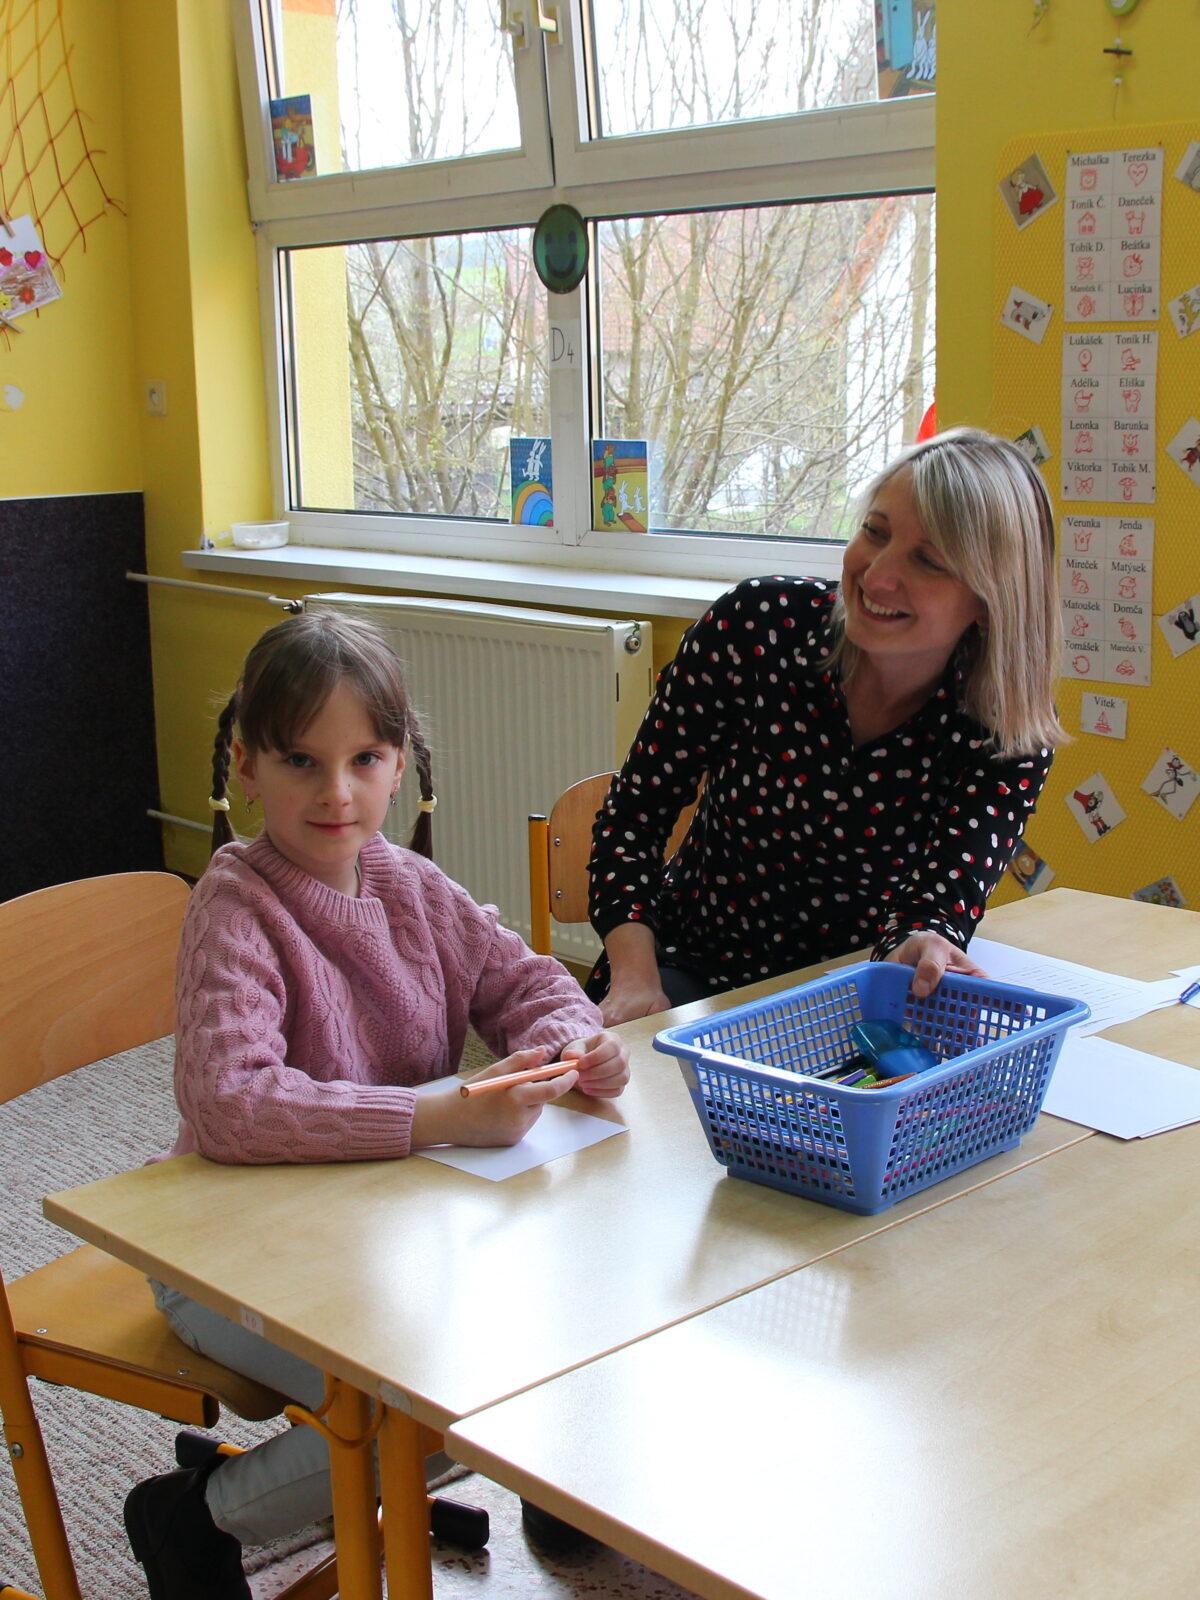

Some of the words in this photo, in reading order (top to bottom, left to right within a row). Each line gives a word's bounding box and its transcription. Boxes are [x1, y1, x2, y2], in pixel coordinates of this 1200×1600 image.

[1122, 151, 1157, 163] Terezka
[1118, 196, 1154, 207] Daneček
[1095, 242, 1105, 252] D.
[1069, 335, 1103, 345] Lukášek
[1142, 333, 1153, 344] H.
[1119, 377, 1145, 387] Eliška
[1070, 420, 1099, 430] Leonka
[1115, 420, 1149, 430] Barunka
[1067, 461, 1102, 472] Viktorka
[1138, 463, 1151, 473] M.
[1067, 517, 1101, 528] Verunka
[1119, 519, 1143, 530] Jenda
[1111, 561, 1146, 574] Matýsek
[1063, 599, 1101, 611] Matoušek
[1113, 603, 1143, 615] Domča
[1064, 639, 1100, 652] Tomášek
